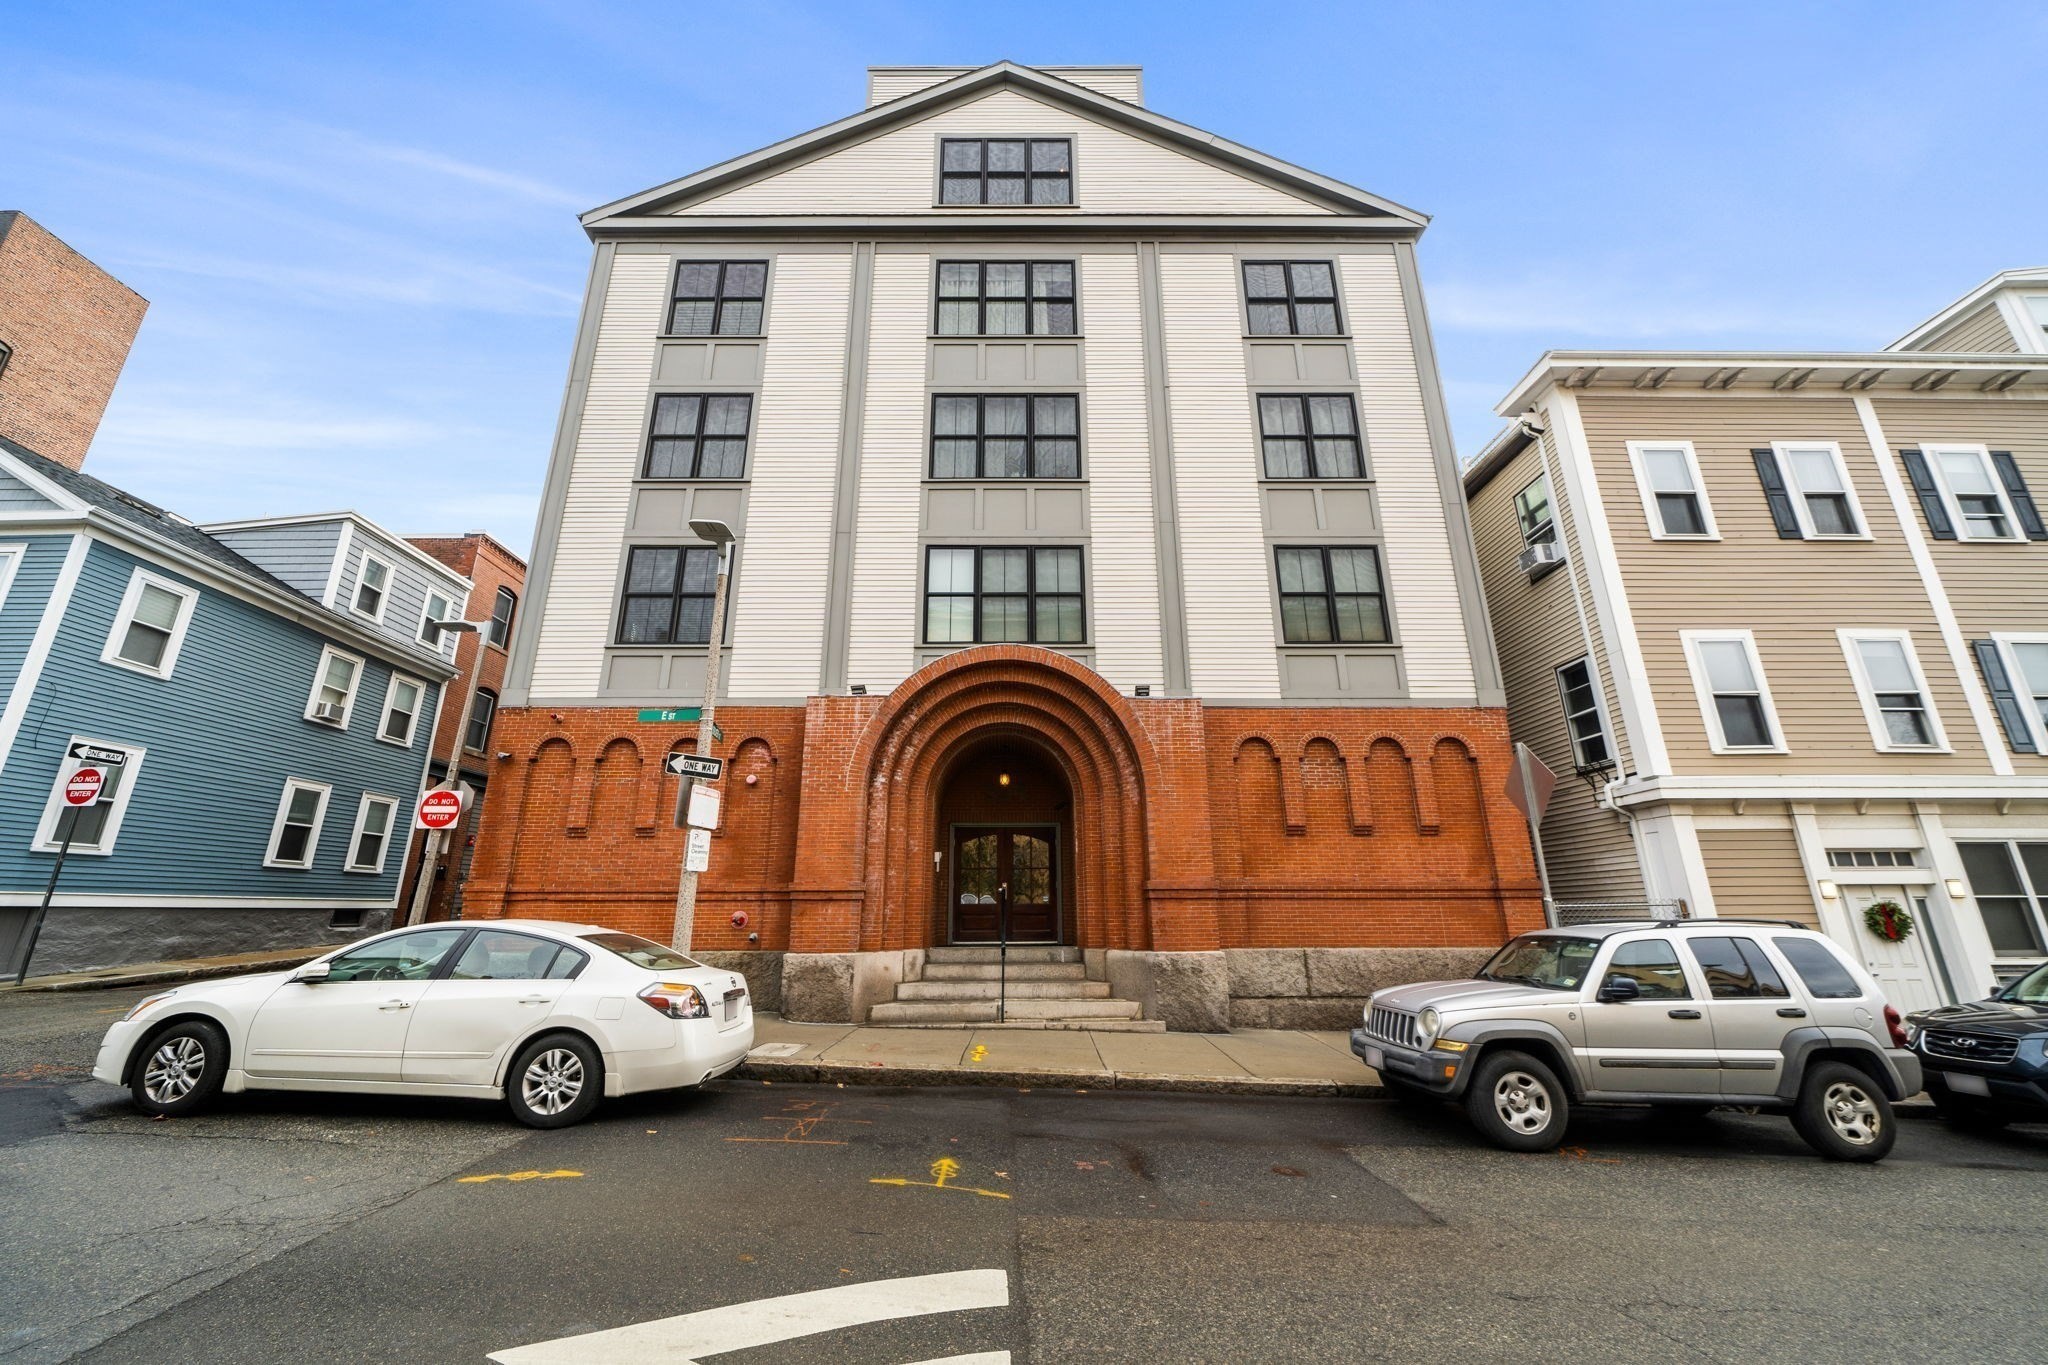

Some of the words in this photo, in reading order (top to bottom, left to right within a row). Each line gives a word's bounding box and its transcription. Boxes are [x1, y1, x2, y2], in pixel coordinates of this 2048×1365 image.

[661, 711, 668, 720] E
[86, 749, 101, 757] ONE
[683, 760, 699, 770] ONE
[701, 763, 717, 773] WAY
